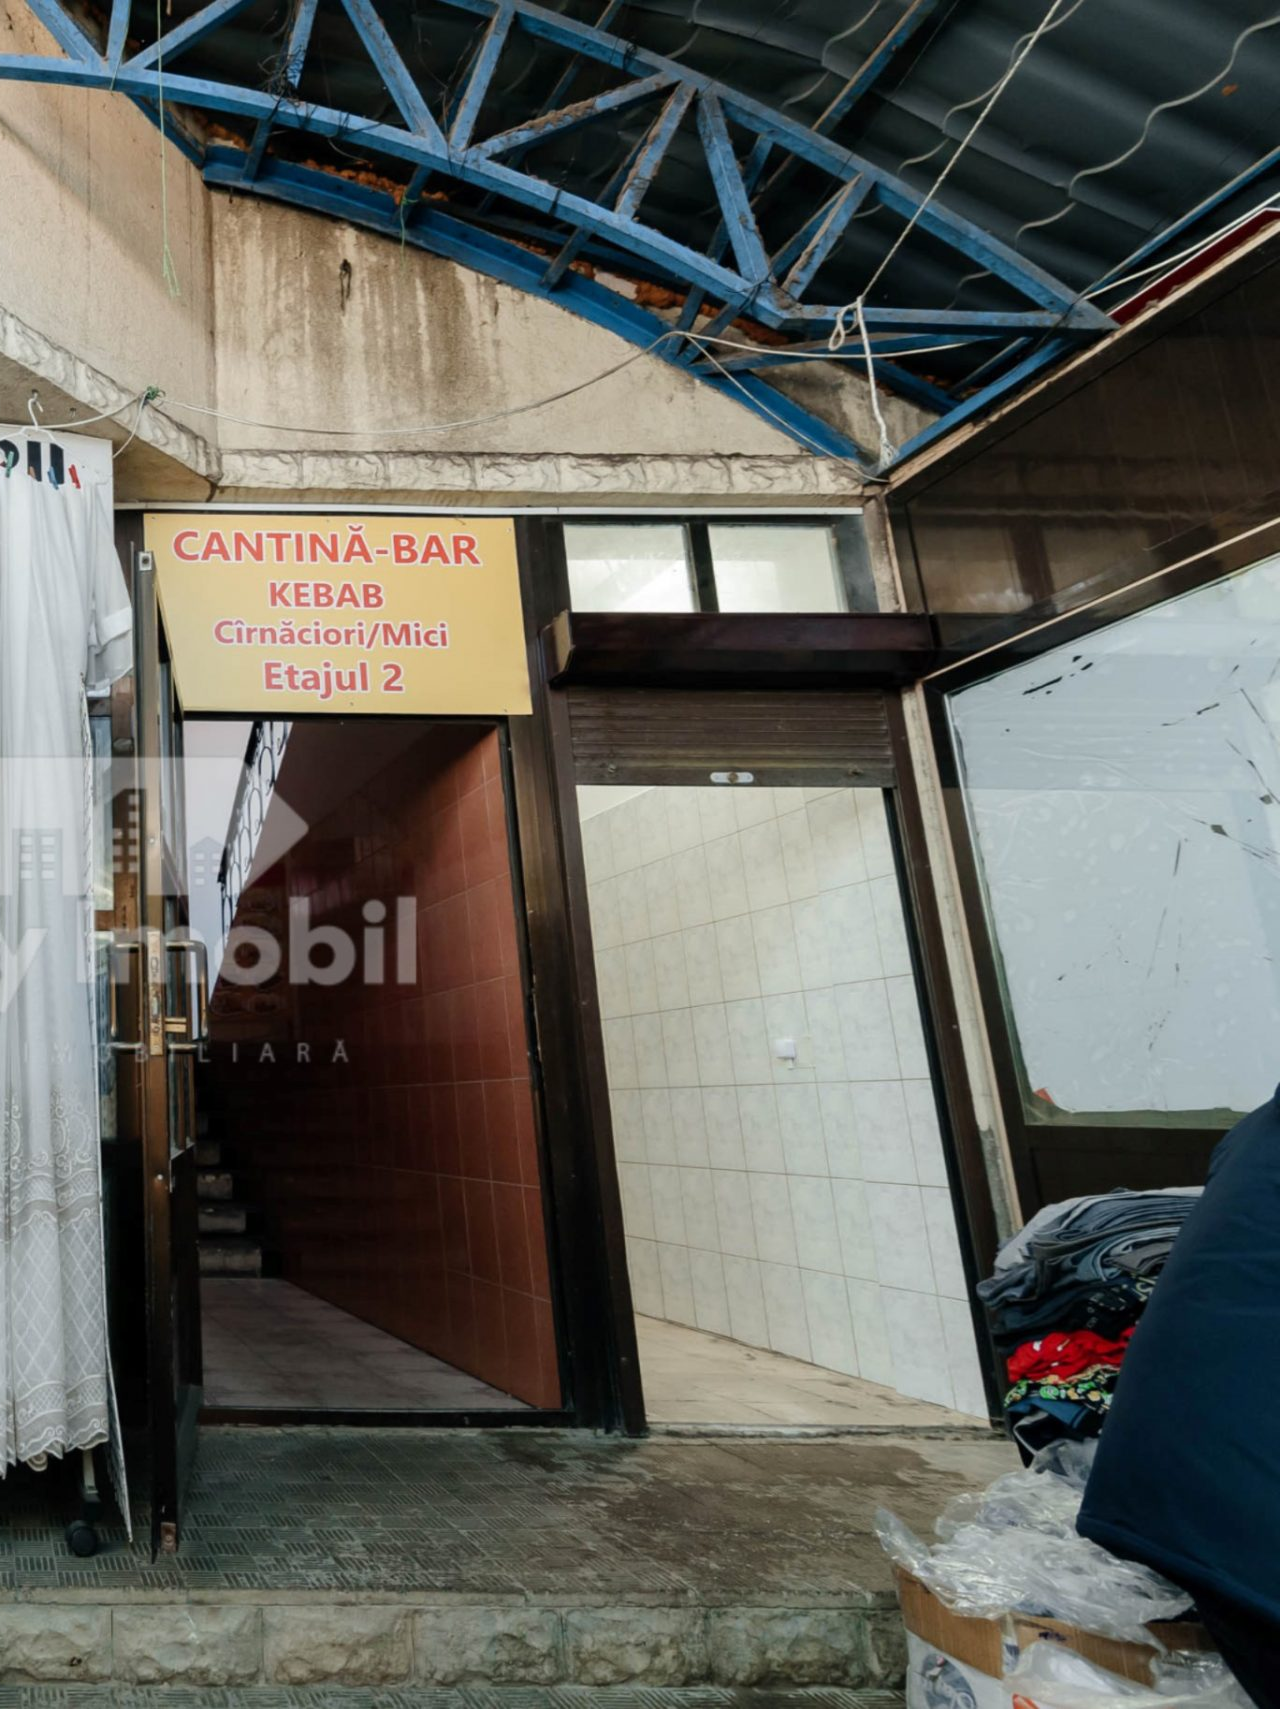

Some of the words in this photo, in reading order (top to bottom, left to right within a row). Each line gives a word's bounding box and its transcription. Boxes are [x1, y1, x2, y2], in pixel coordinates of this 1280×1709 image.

[173, 525, 481, 565] CANTINĂ-BAR
[269, 582, 385, 609] KEBAB
[214, 619, 449, 649] Cîrnăciori/Mici
[263, 661, 370, 699] Etajul
[382, 663, 405, 692] 2
